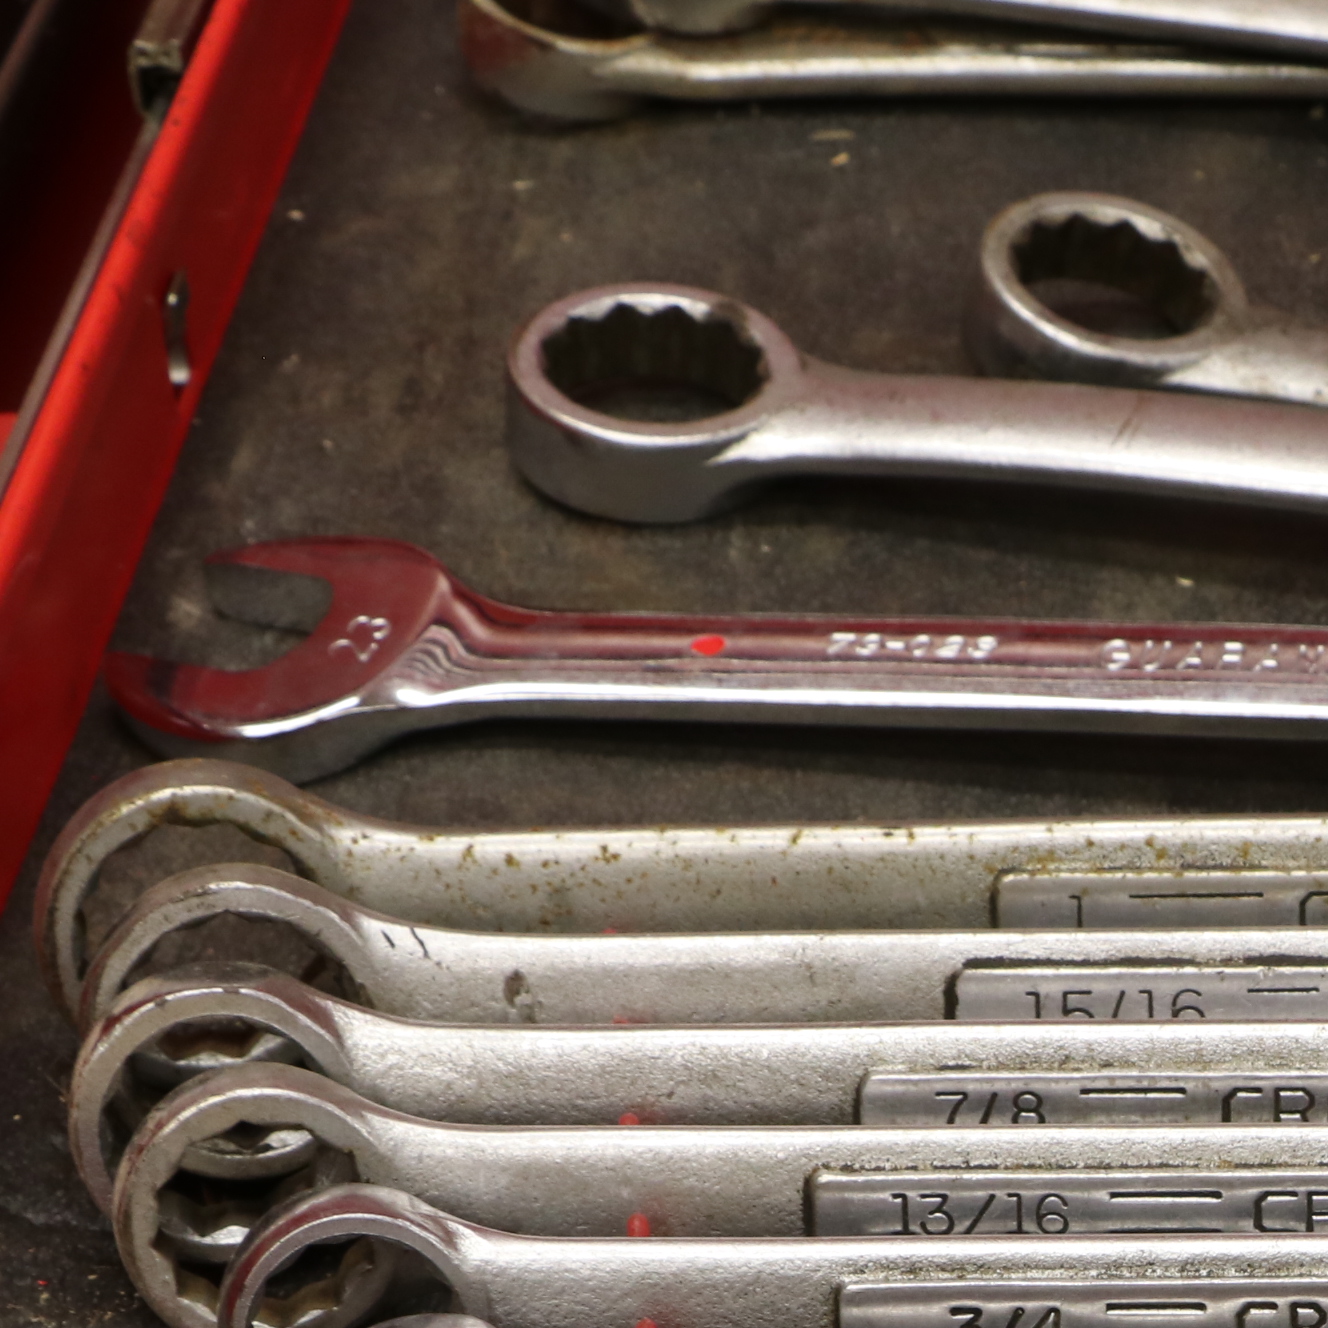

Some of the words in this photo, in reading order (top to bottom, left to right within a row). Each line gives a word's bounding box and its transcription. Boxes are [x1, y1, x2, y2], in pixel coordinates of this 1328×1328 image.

[328, 615, 391, 662] 23
[935, 1091, 1046, 1124] 7/8
[890, 1192, 1070, 1235] 13/16
